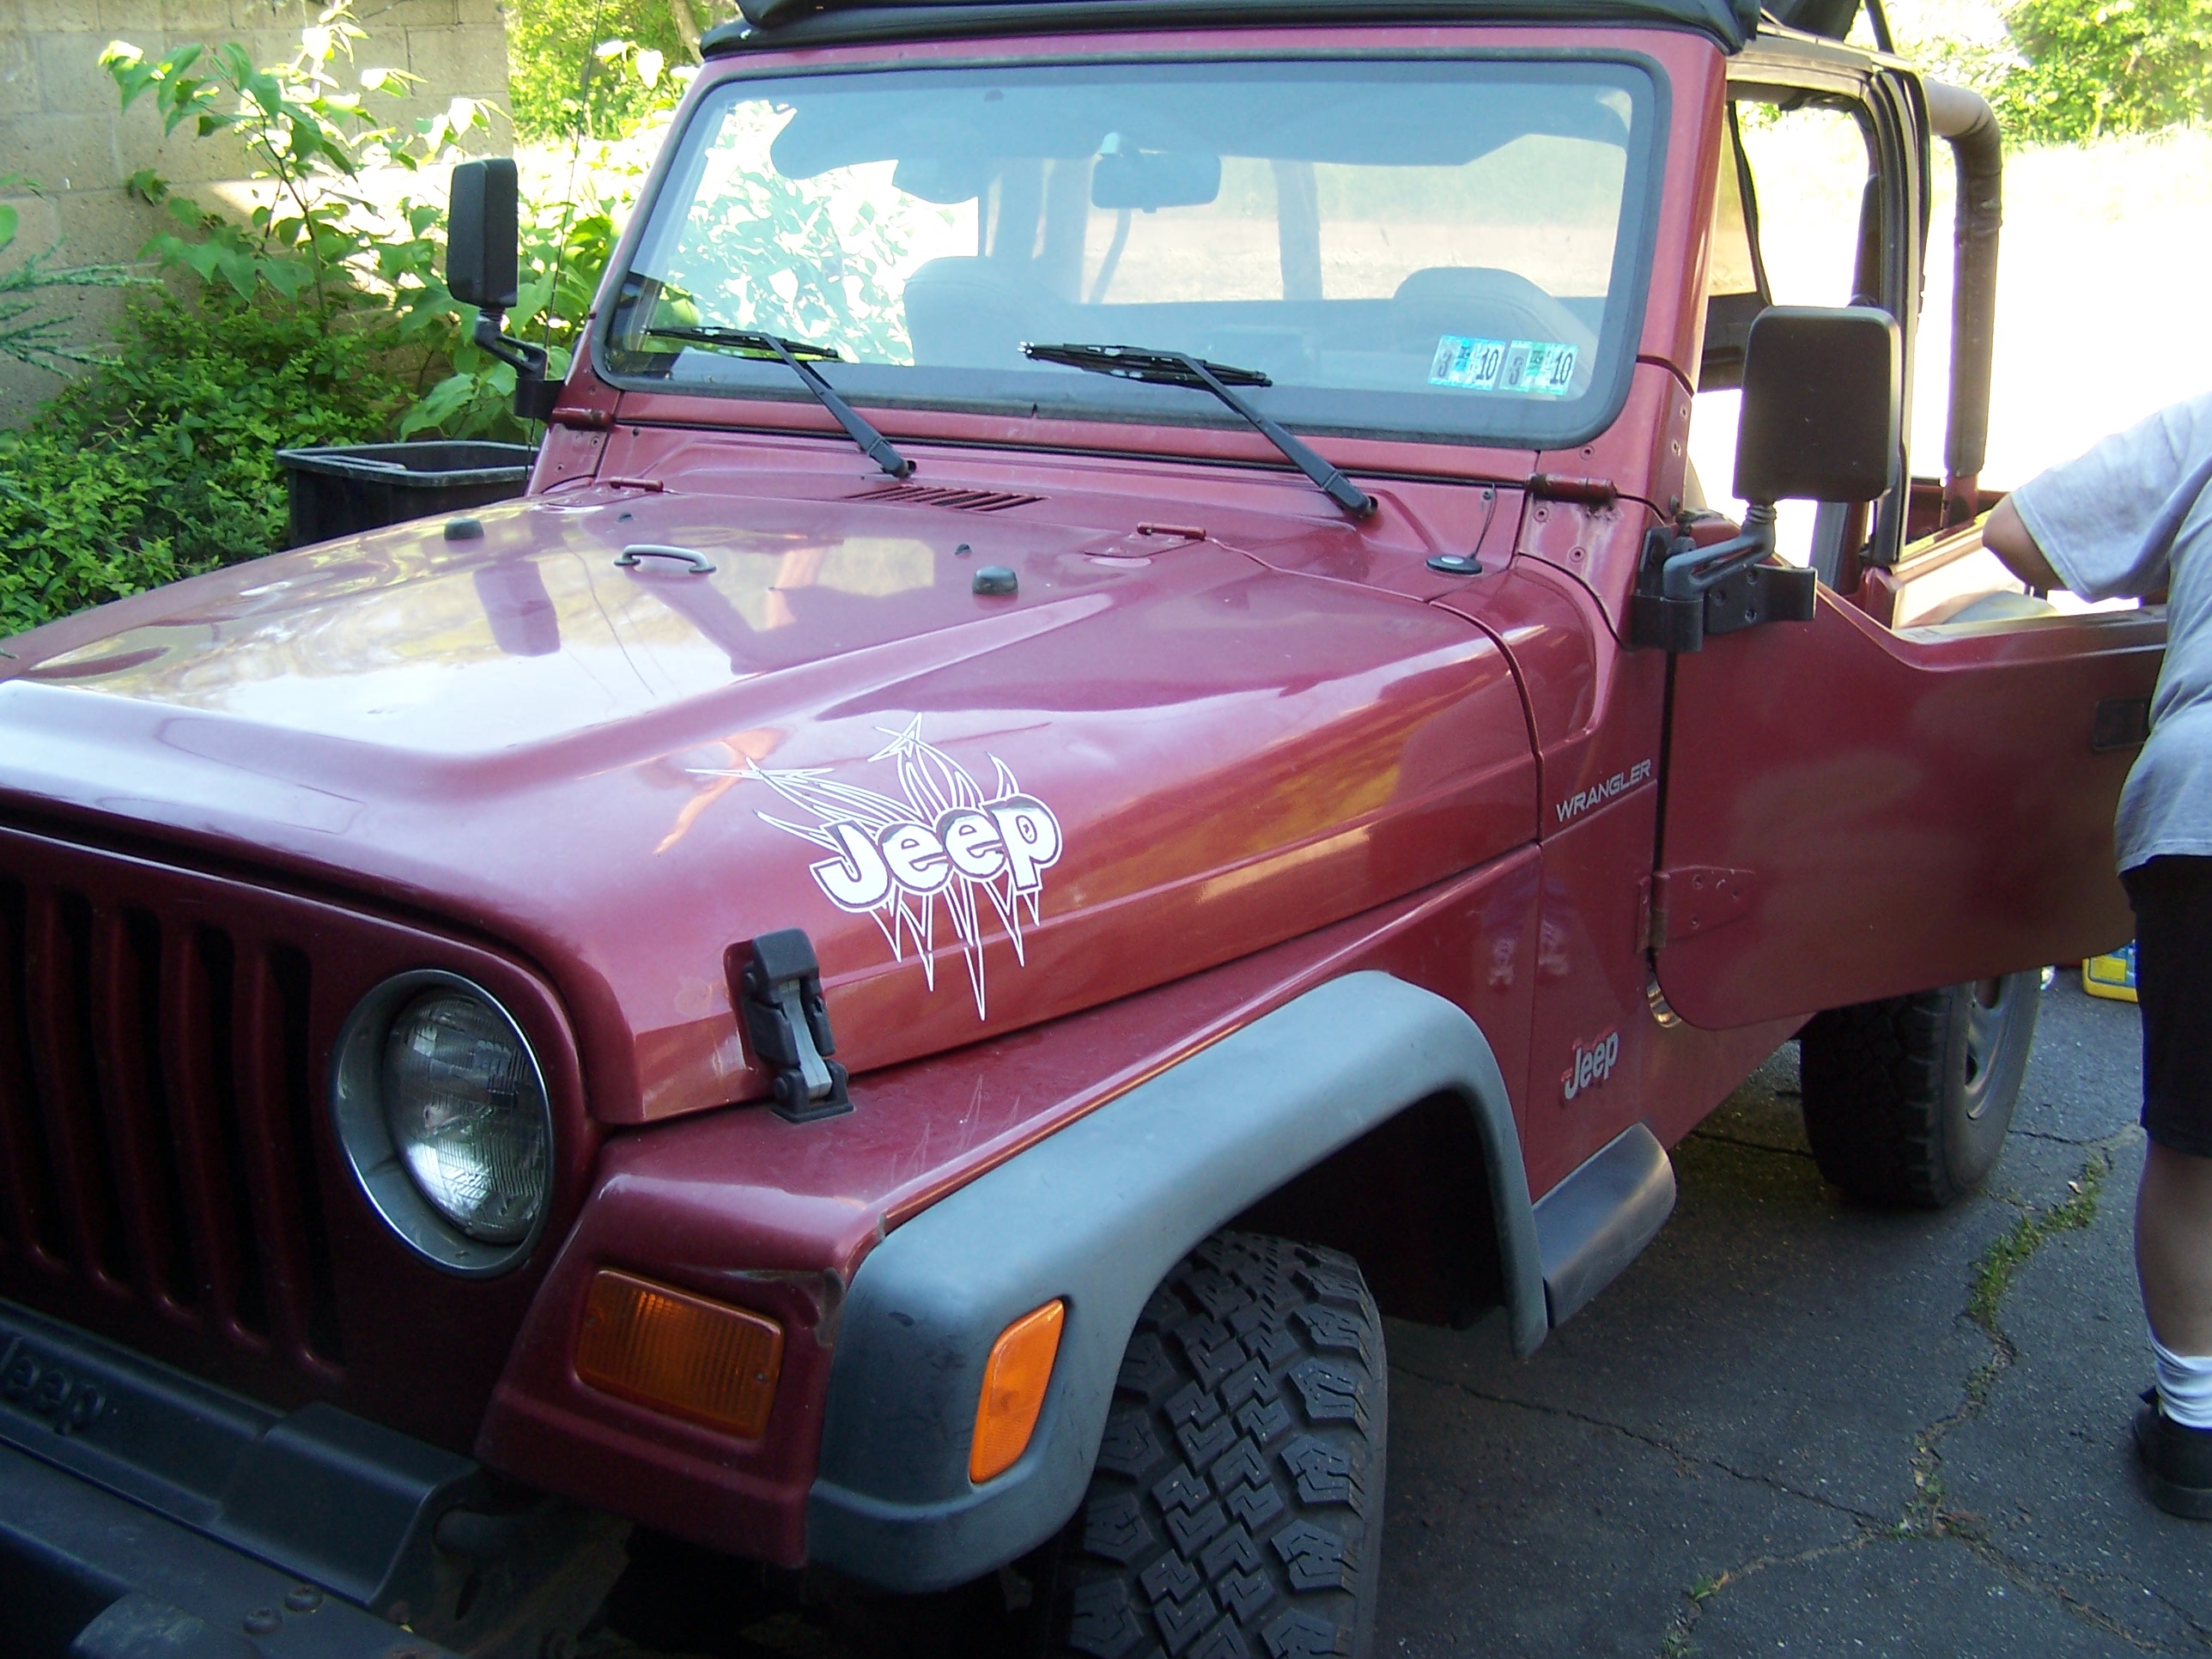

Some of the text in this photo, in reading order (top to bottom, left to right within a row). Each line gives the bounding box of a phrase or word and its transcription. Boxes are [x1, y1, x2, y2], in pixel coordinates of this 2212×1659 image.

[1437, 350, 1452, 378] 3
[1476, 348, 1499, 380] 10
[1509, 356, 1524, 386] 3
[1550, 351, 1573, 386] 10
[1555, 758, 1651, 823] WRANGLER
[809, 793, 1062, 913] Jeep
[1564, 1031, 1619, 1100] Jeep
